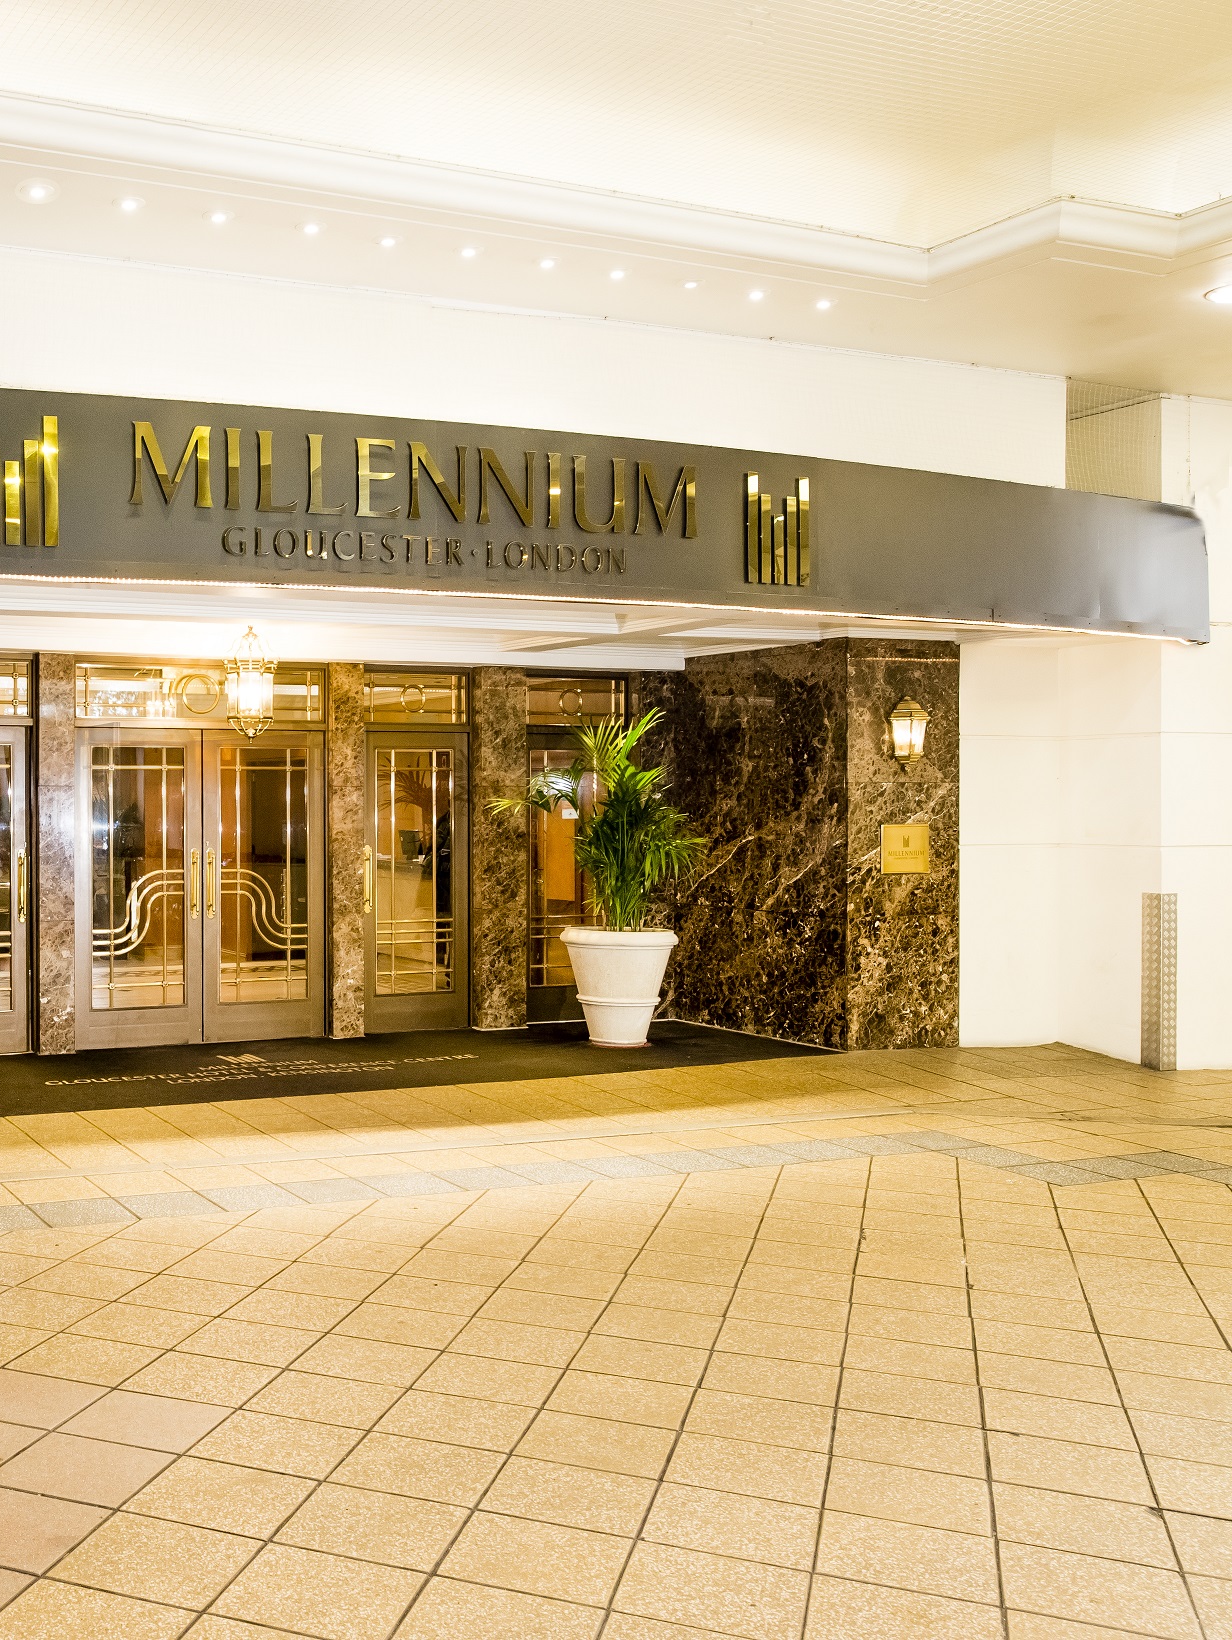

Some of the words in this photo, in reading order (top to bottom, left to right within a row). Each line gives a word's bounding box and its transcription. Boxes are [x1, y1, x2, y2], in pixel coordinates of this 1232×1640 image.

[129, 420, 699, 539] MILLENNIUM
[221, 525, 463, 567] GLOUCESTER
[486, 539, 628, 575] LONDON
[44, 1073, 185, 1086] GLOUCESTER
[187, 1068, 253, 1077] HOTEL
[403, 1053, 479, 1063] CENTRE
